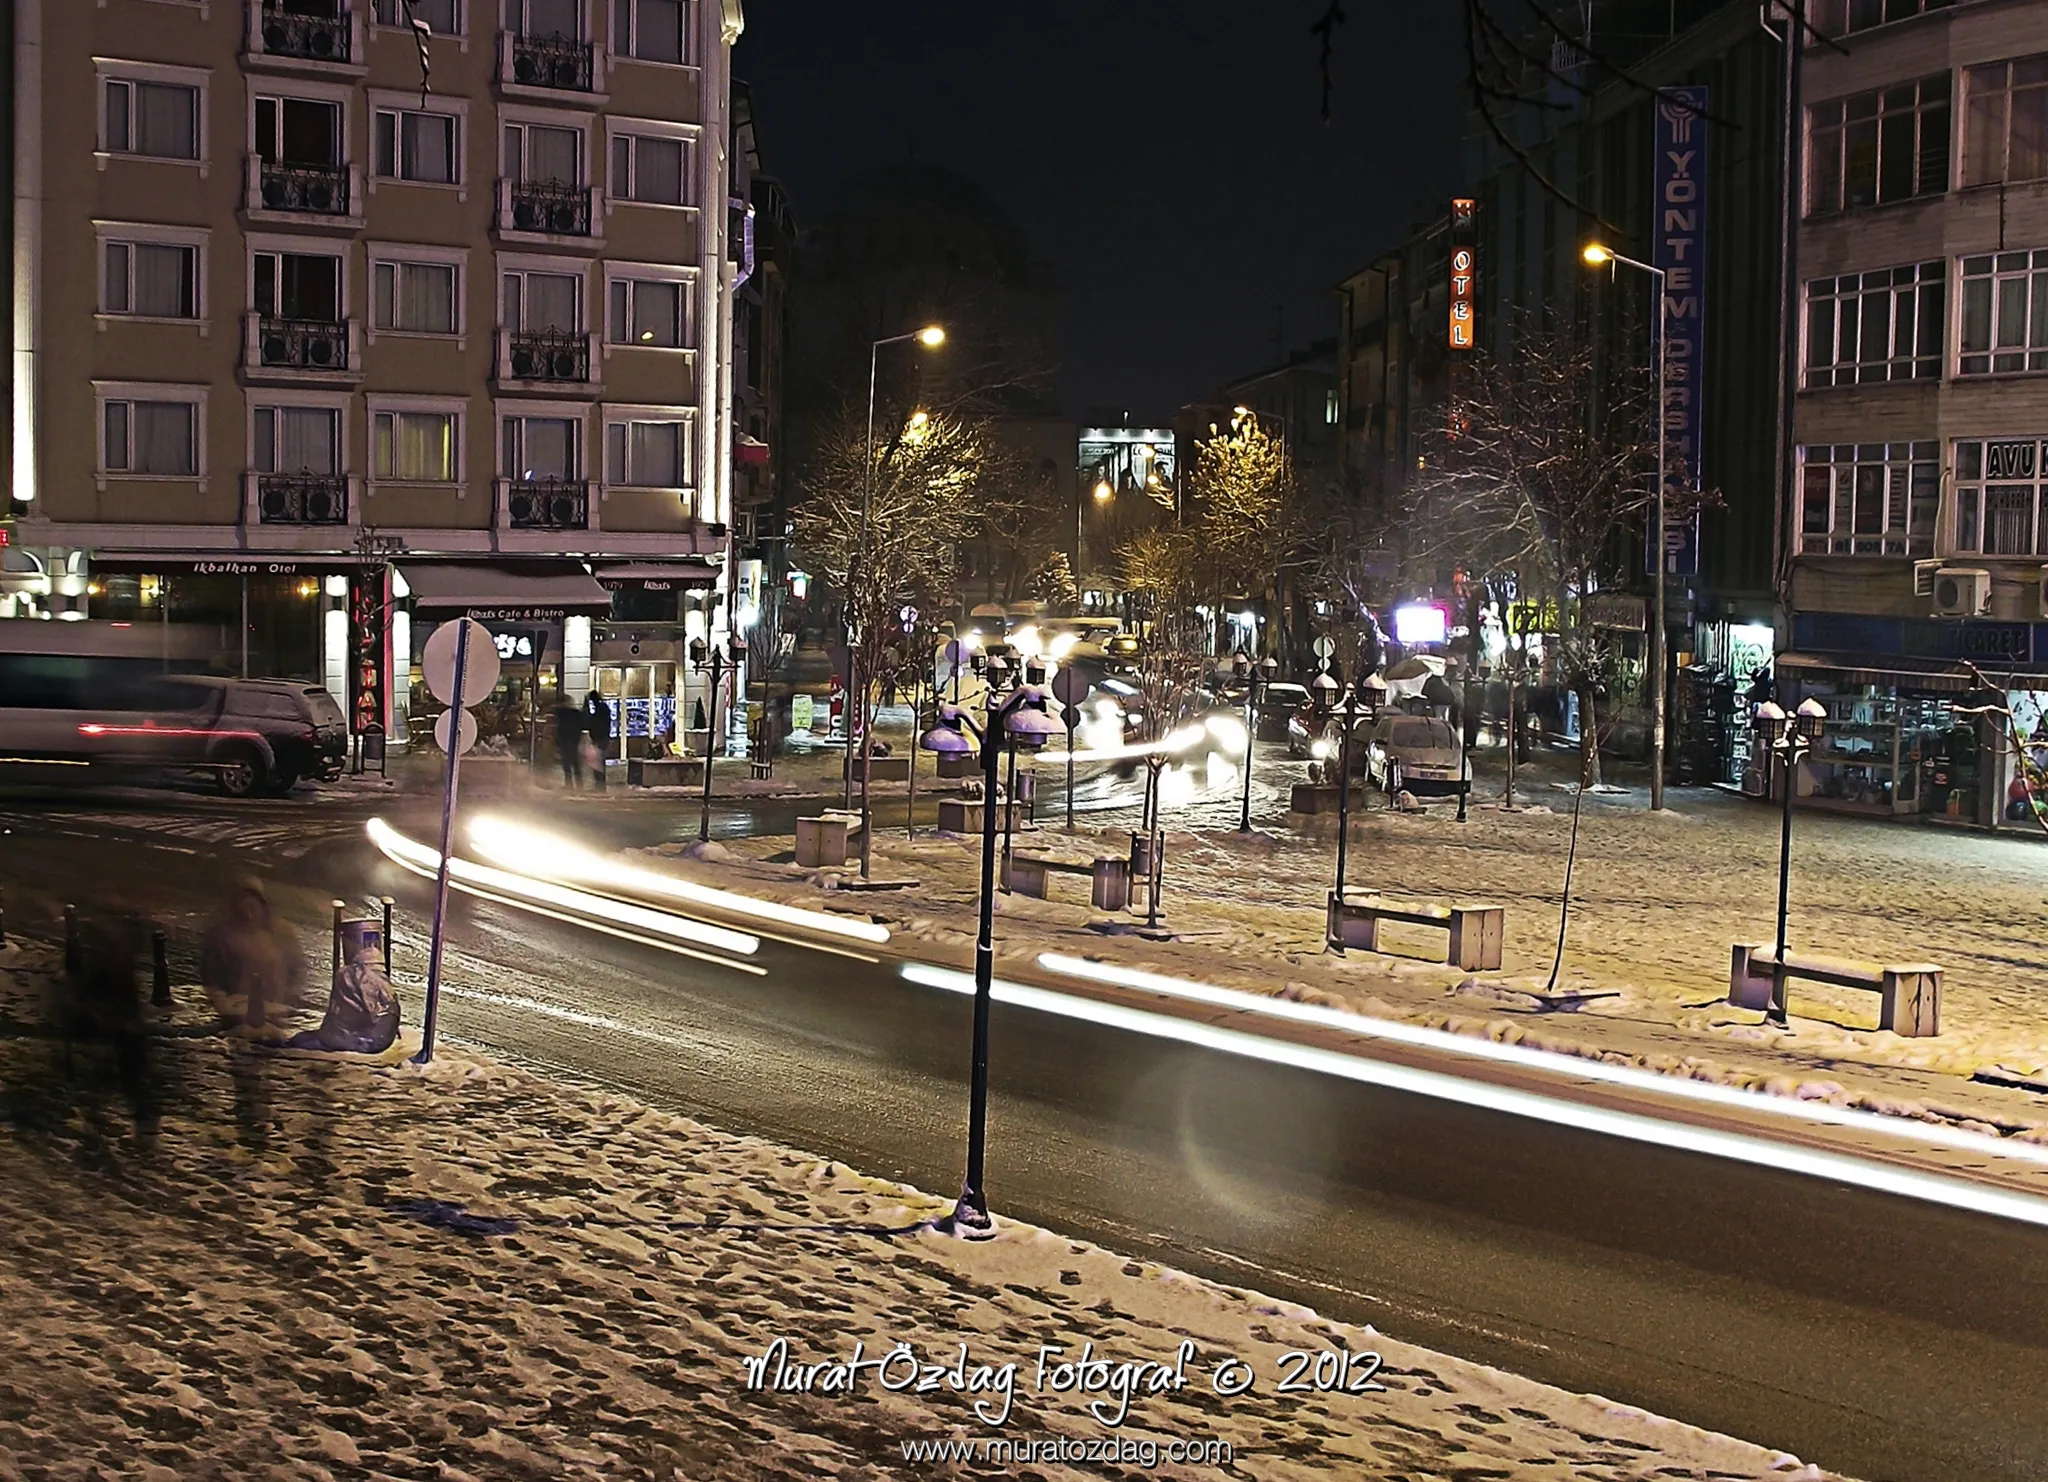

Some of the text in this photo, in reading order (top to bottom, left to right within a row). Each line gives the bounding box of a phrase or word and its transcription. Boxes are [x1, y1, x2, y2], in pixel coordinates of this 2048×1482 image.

[1663, 148, 1698, 319] YÖNTEM
[1453, 250, 1471, 346] OTEL
[268, 563, 297, 574] Otel
[497, 609, 521, 619] Cafe
[533, 608, 565, 617] Bistro
